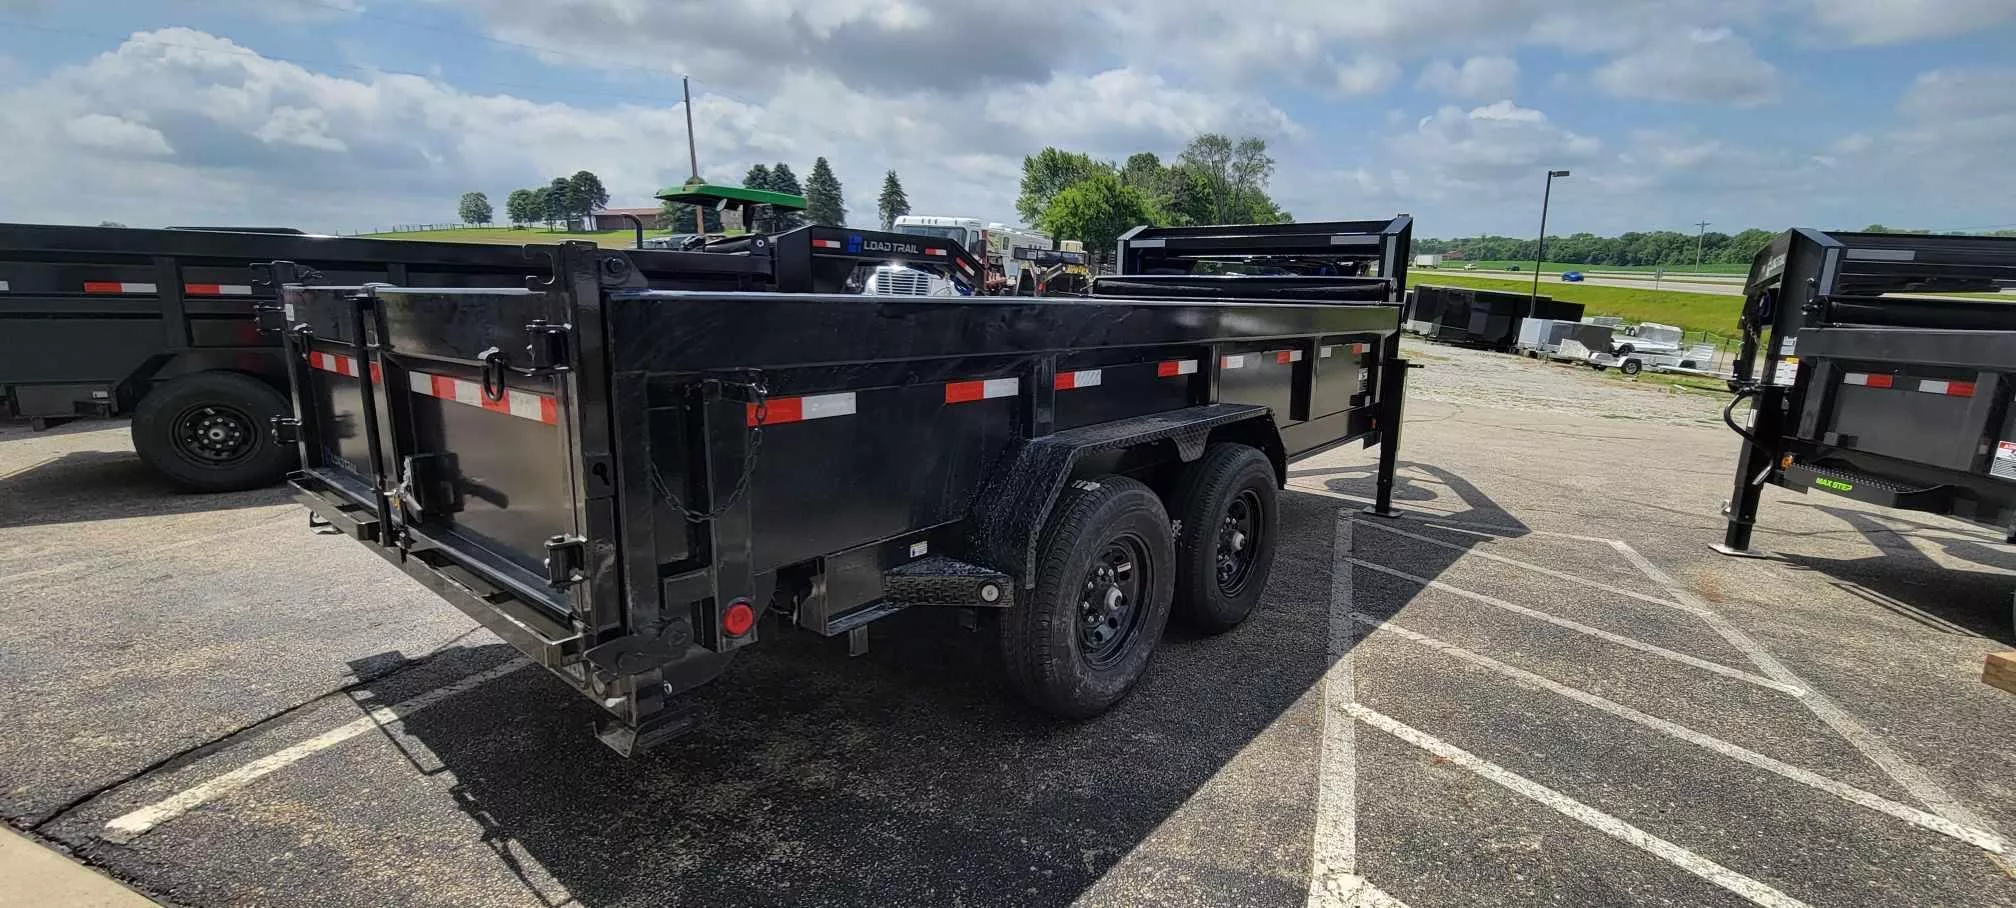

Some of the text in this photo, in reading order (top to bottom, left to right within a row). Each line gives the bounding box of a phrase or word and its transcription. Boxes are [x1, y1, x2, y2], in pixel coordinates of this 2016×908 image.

[863, 240, 919, 254] LOAD TRAIL
[1815, 477, 1853, 491] MAX STEP
